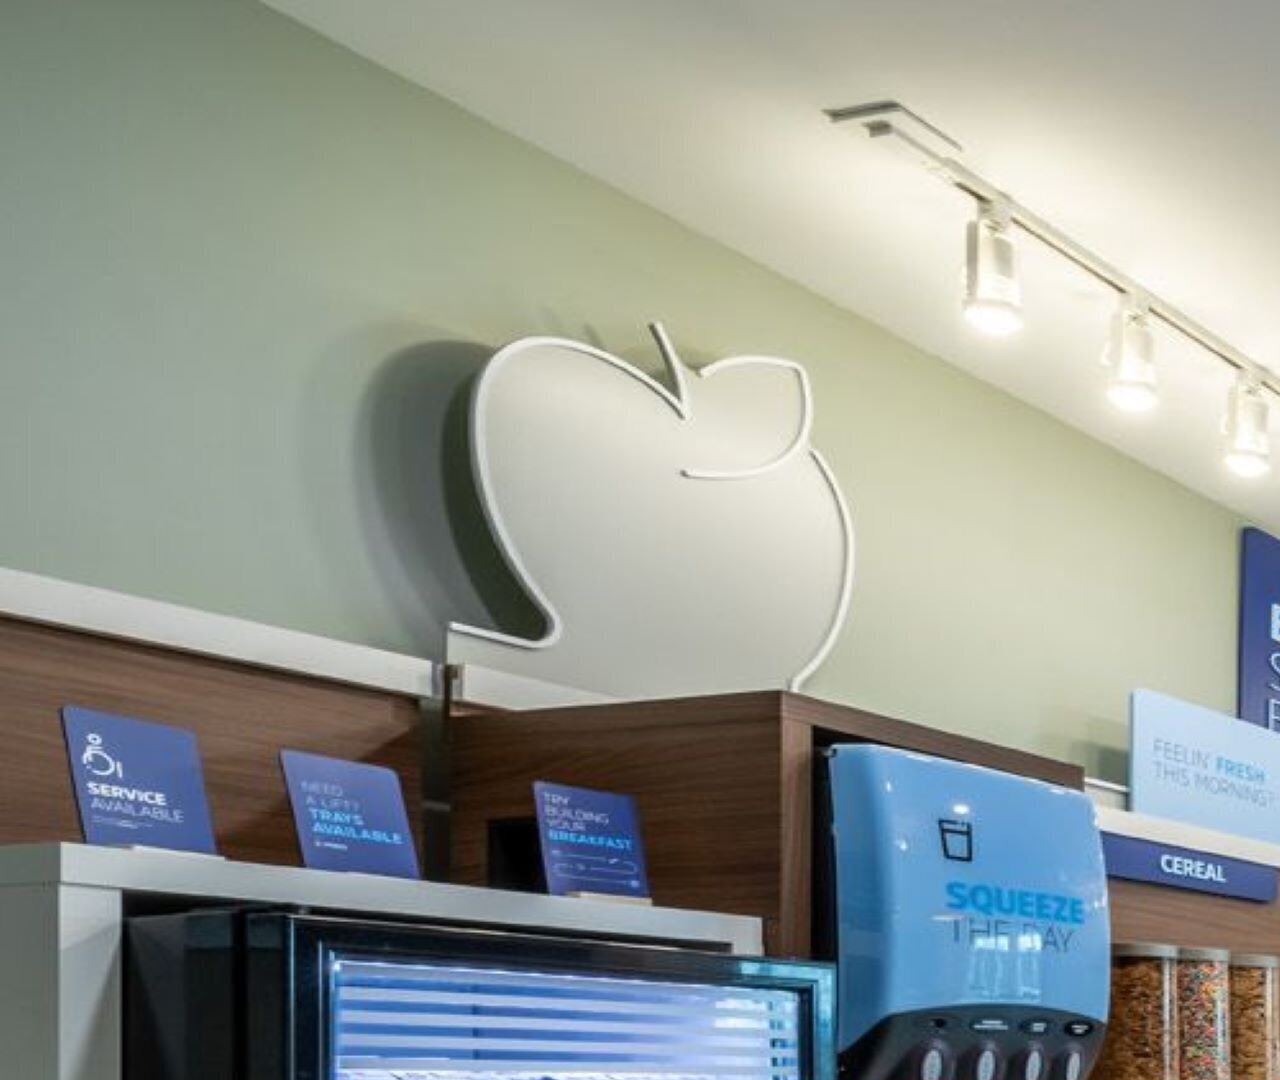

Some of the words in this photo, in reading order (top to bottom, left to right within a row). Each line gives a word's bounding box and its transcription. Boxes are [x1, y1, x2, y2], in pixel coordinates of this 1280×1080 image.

[1152, 760, 1190, 787] THIS
[1216, 756, 1266, 784] FRESH
[86, 782, 167, 806] SERVICE
[90, 799, 185, 823] AVAILABLE
[308, 808, 364, 826] TRAYS
[313, 822, 404, 845] AVAILABLE
[1161, 853, 1227, 882] CEREAL
[946, 881, 1084, 925] SQUEEZE
